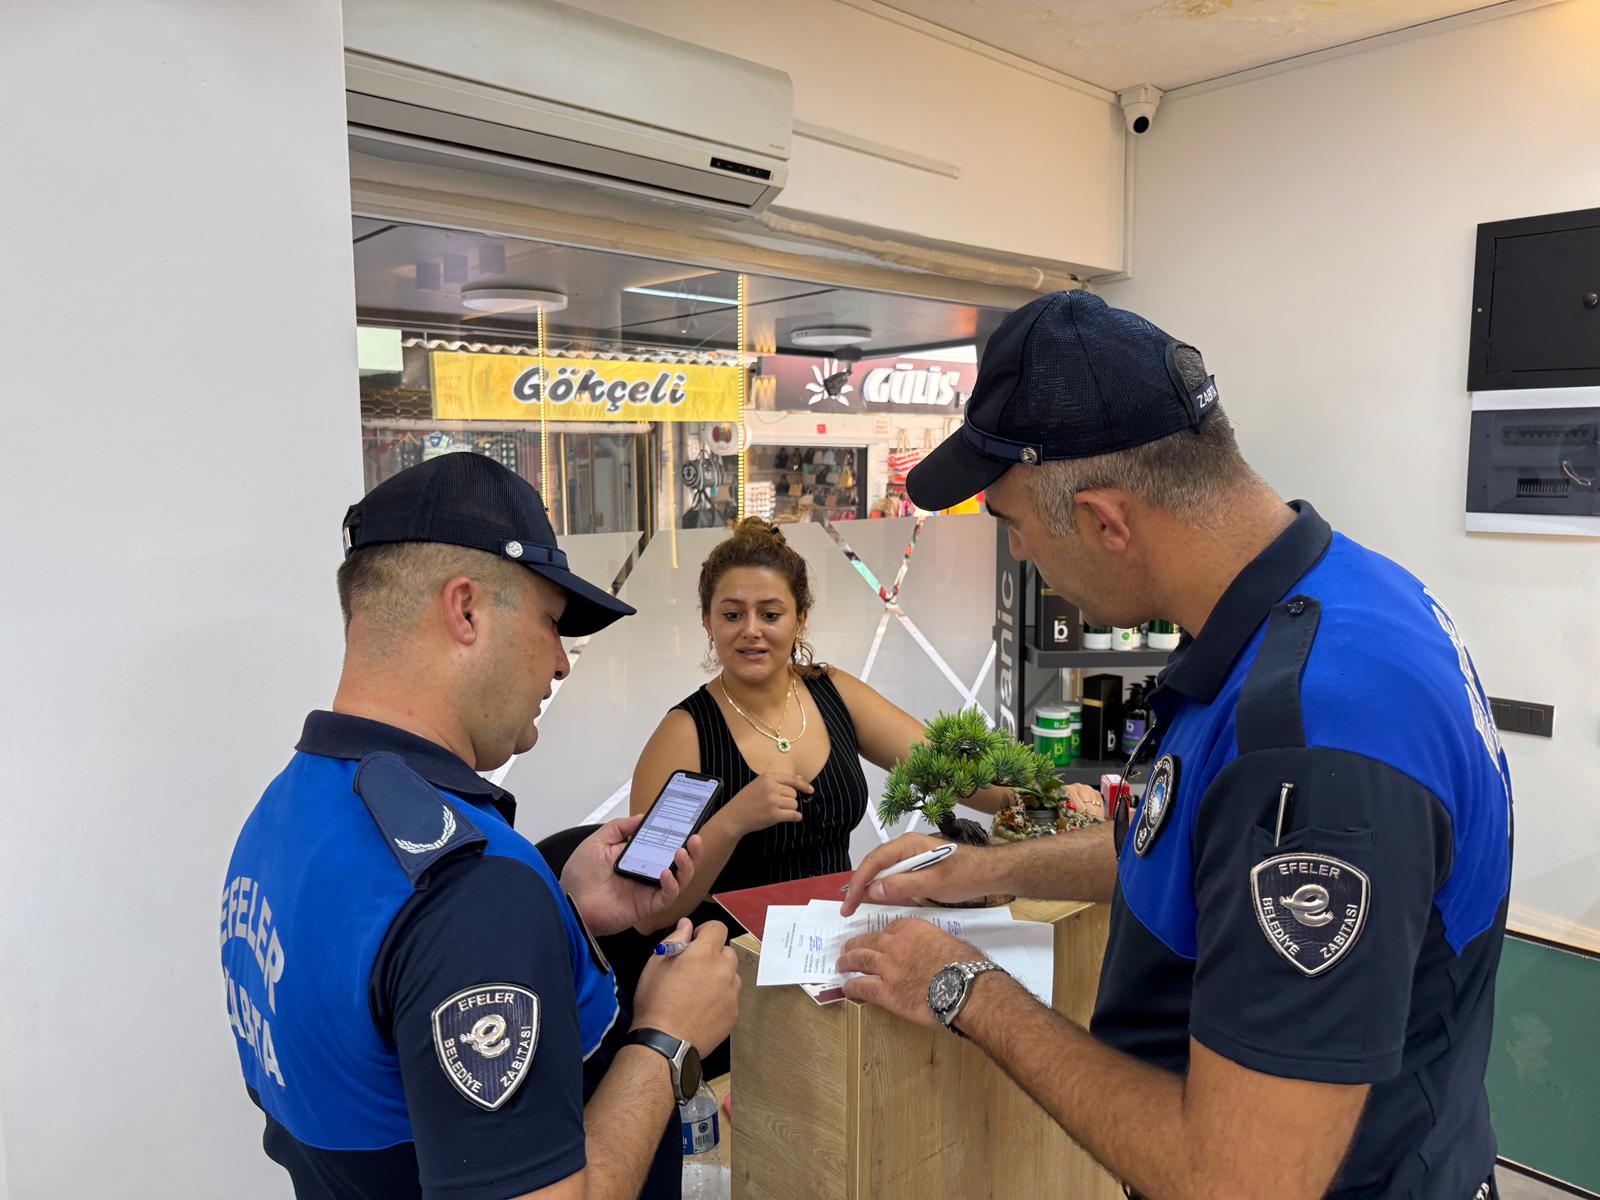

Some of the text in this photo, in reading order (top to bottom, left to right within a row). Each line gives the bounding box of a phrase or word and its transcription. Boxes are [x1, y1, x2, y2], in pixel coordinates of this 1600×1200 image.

[513, 366, 686, 412] Gökçeli
[1196, 385, 1217, 409] ZAB
[1278, 862, 1341, 879] EFELER
[220, 876, 285, 1016] EFELER
[1261, 897, 1359, 960] BELEDİYE ZABITASI
[223, 966, 287, 1088] ABTA
[458, 992, 515, 1012] EFELER
[444, 1025, 532, 1094] BELEDİYE ZABITASI
